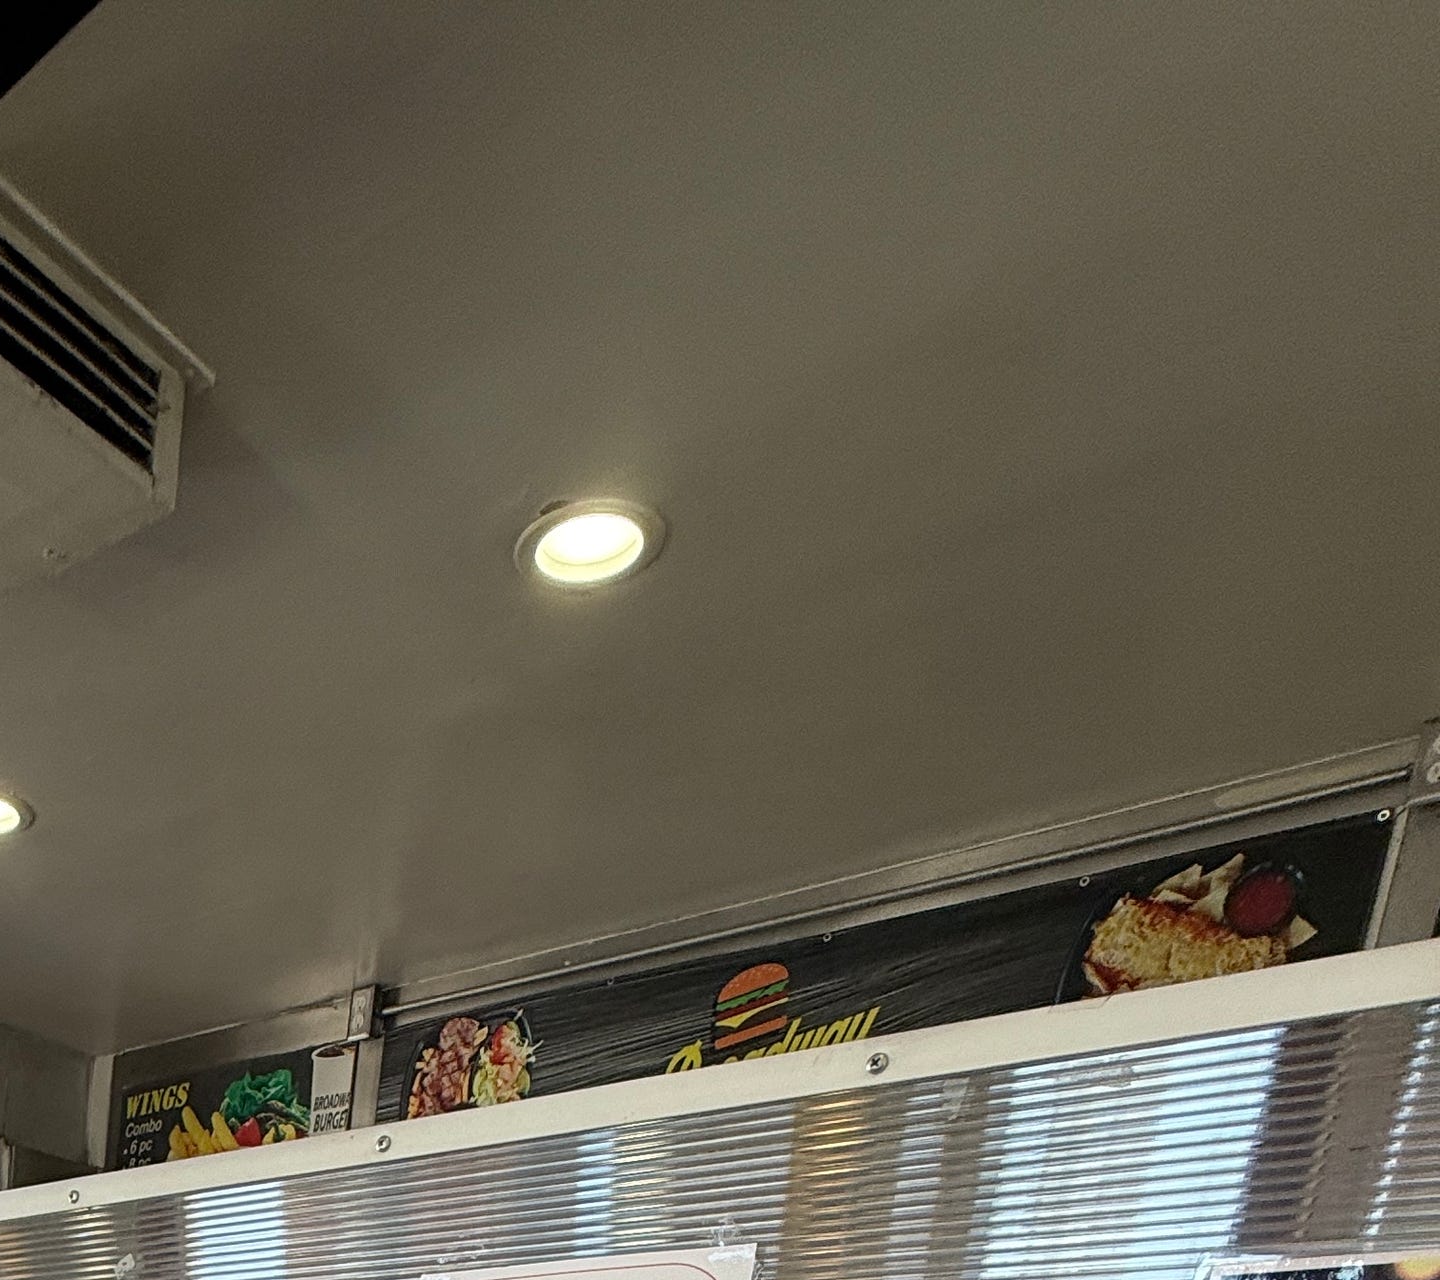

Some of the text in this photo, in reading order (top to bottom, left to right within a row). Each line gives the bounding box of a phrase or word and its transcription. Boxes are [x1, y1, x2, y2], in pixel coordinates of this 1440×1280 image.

[126, 1082, 191, 1119] WINGS
[125, 1119, 162, 1138] Combo
[138, 1140, 153, 1156] pc
